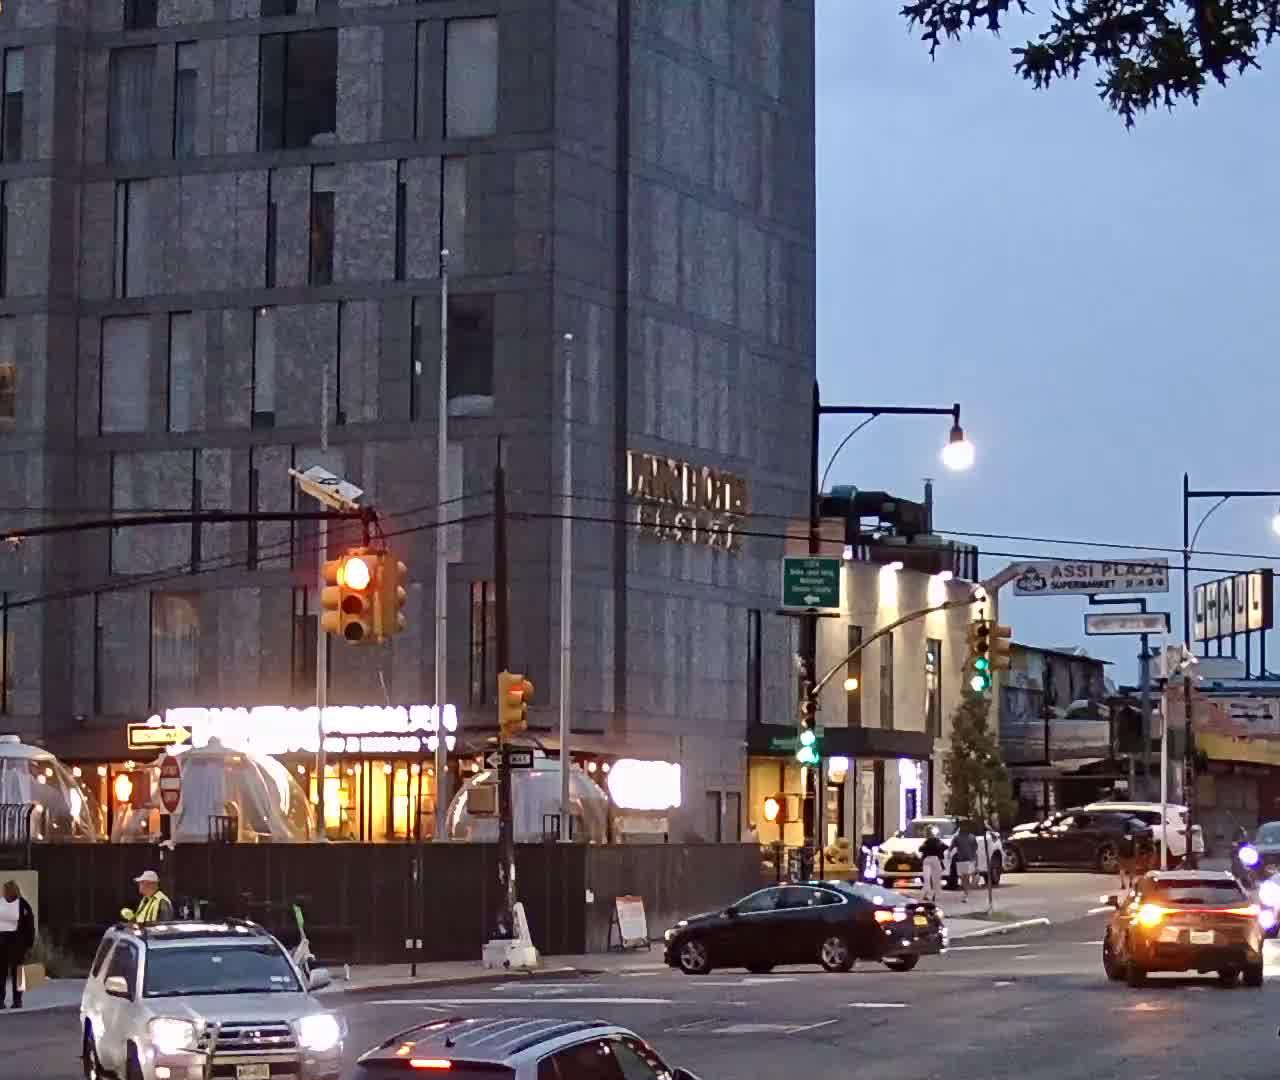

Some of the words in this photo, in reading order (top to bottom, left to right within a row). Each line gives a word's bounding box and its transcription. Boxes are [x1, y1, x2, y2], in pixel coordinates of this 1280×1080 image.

[1050, 564, 1094, 578] ASSI
[1101, 562, 1165, 577] PLAZA
[1050, 579, 1117, 590] SUPERMARKET
